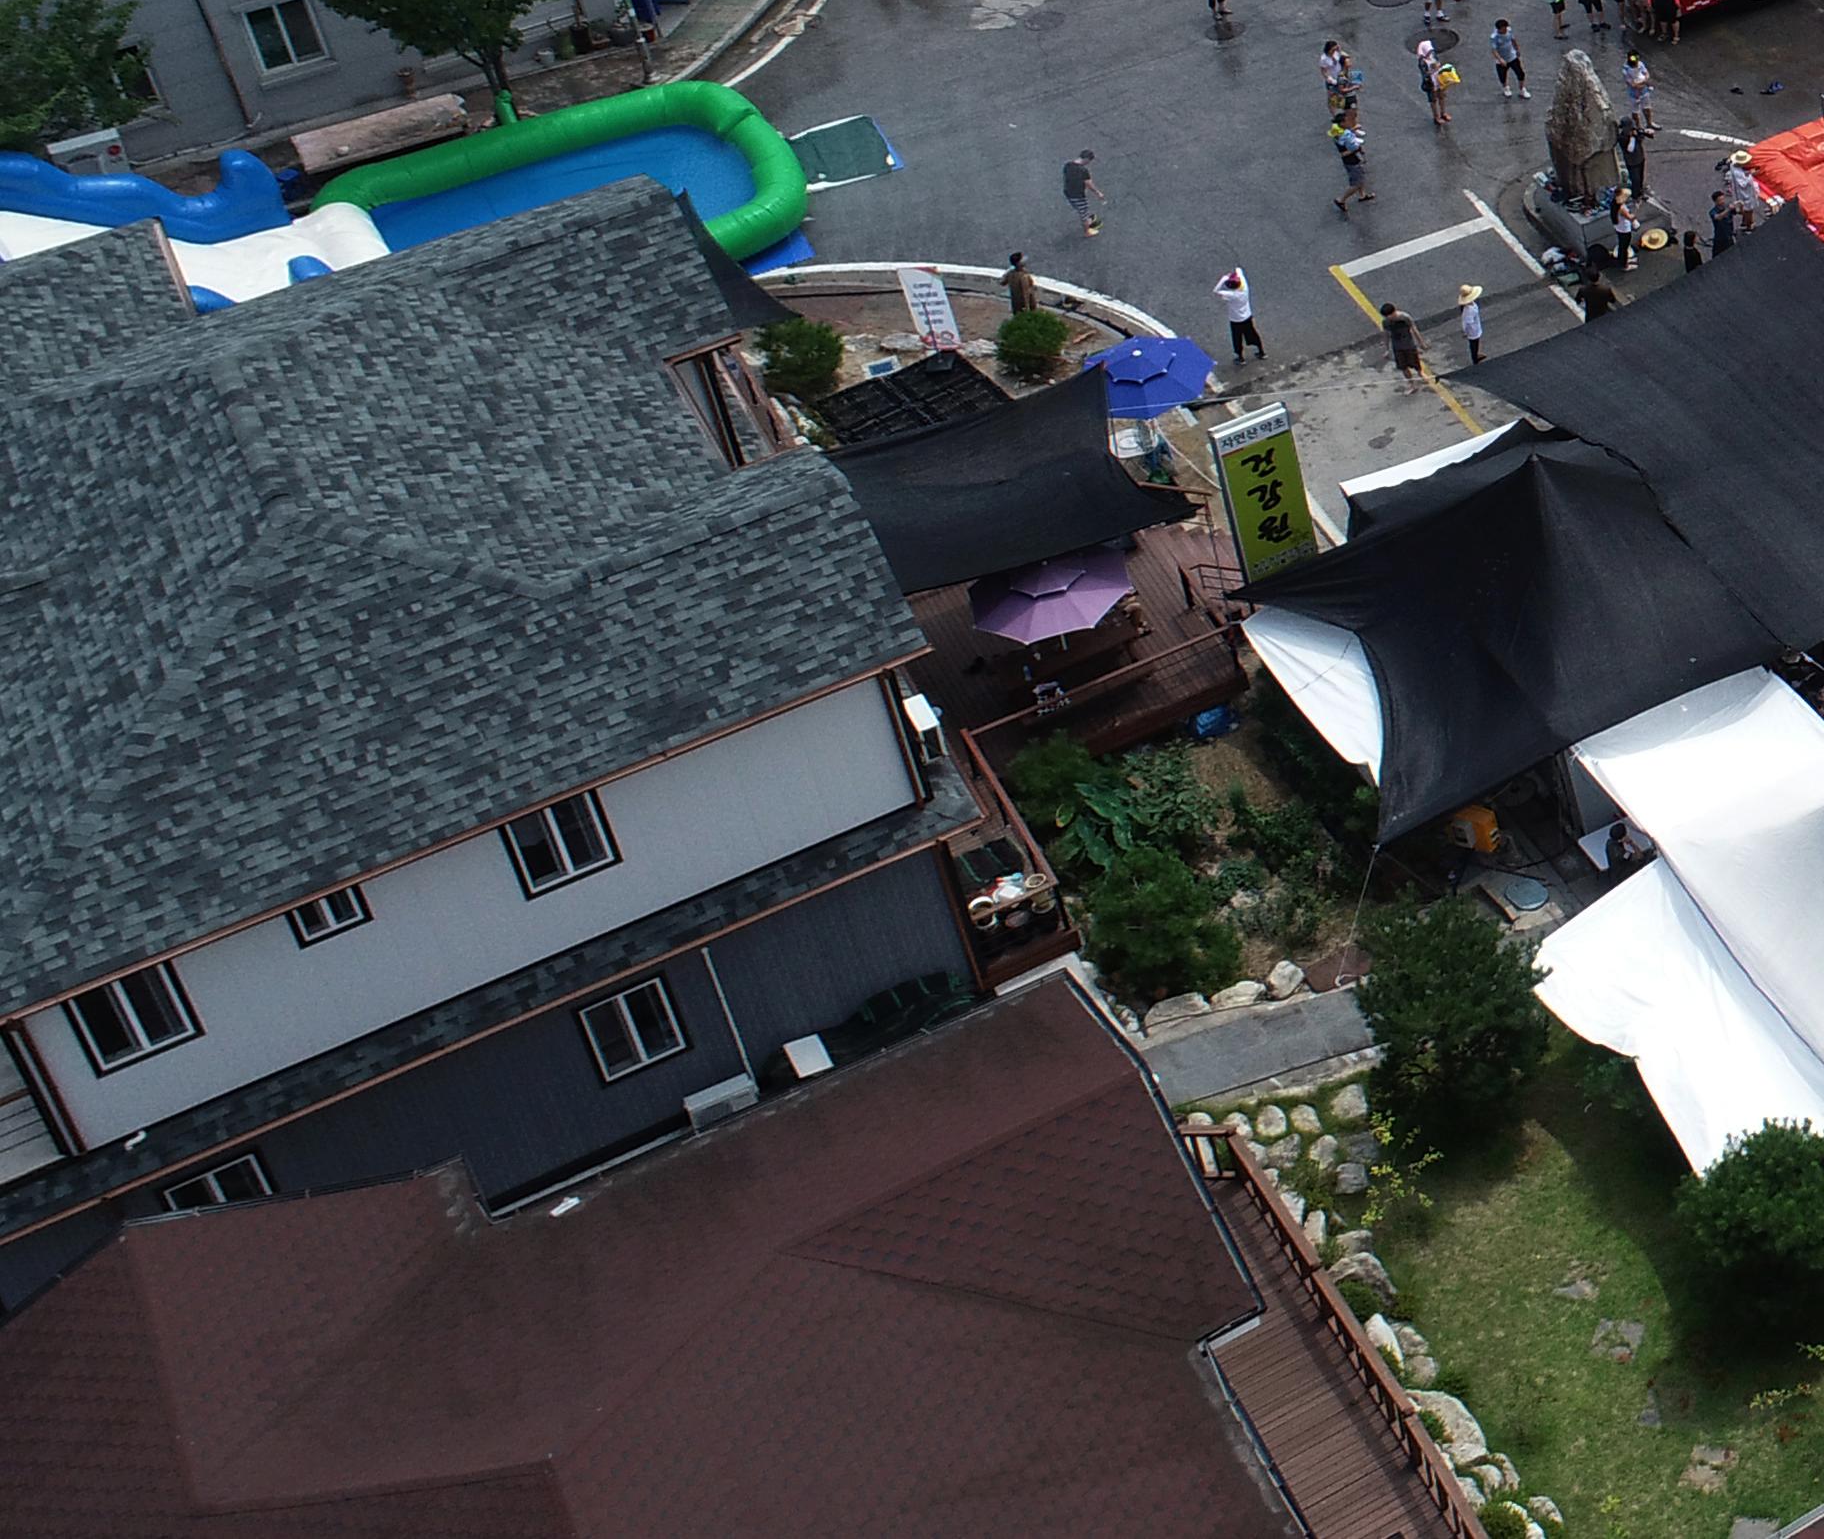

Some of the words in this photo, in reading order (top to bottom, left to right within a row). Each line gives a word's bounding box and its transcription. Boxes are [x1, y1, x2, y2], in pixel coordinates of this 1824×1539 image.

[1220, 428, 1259, 450] 자연산
[1259, 417, 1287, 433] 약초
[1240, 446, 1293, 544] 건강원
